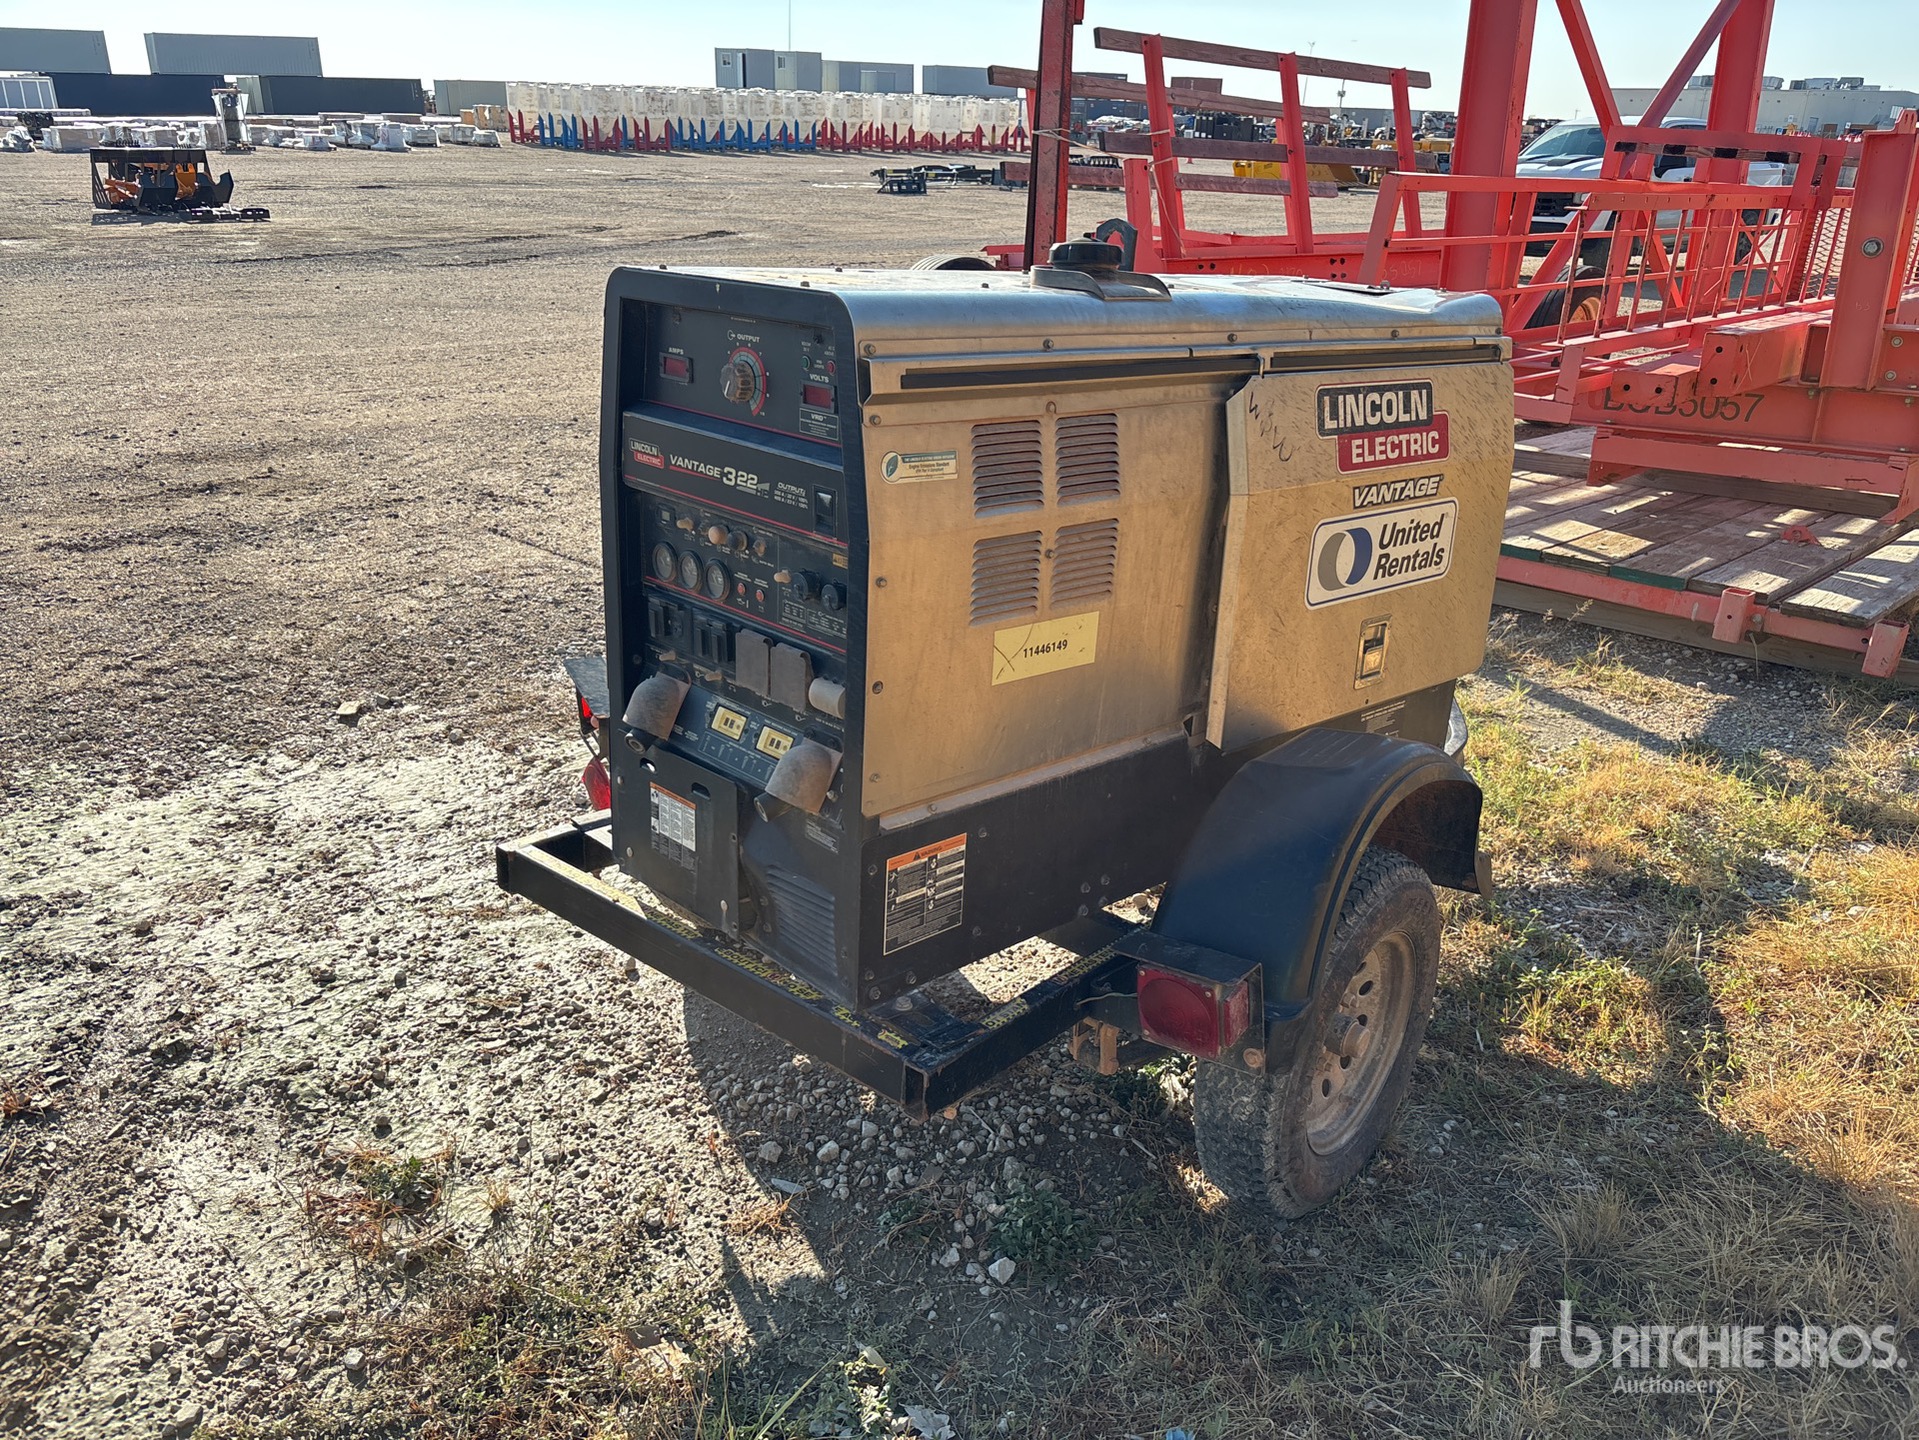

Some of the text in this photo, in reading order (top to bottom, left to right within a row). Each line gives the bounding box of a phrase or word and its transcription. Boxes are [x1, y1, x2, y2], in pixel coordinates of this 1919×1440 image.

[736, 333, 760, 343] OUTPUT
[668, 347, 684, 355] AMPS
[809, 374, 829, 384] VOLTS
[1323, 389, 1428, 430] LINCOLN
[630, 440, 658, 456] LINCOLN
[637, 453, 661, 466] ELECTRIC
[1351, 431, 1440, 464] ELECTRIC
[669, 454, 758, 490] VANTAGE 322
[1353, 476, 1442, 508] VANTAGE
[1378, 513, 1445, 550] United
[1373, 543, 1445, 580] Rentals
[1023, 639, 1068, 658] 11446149
